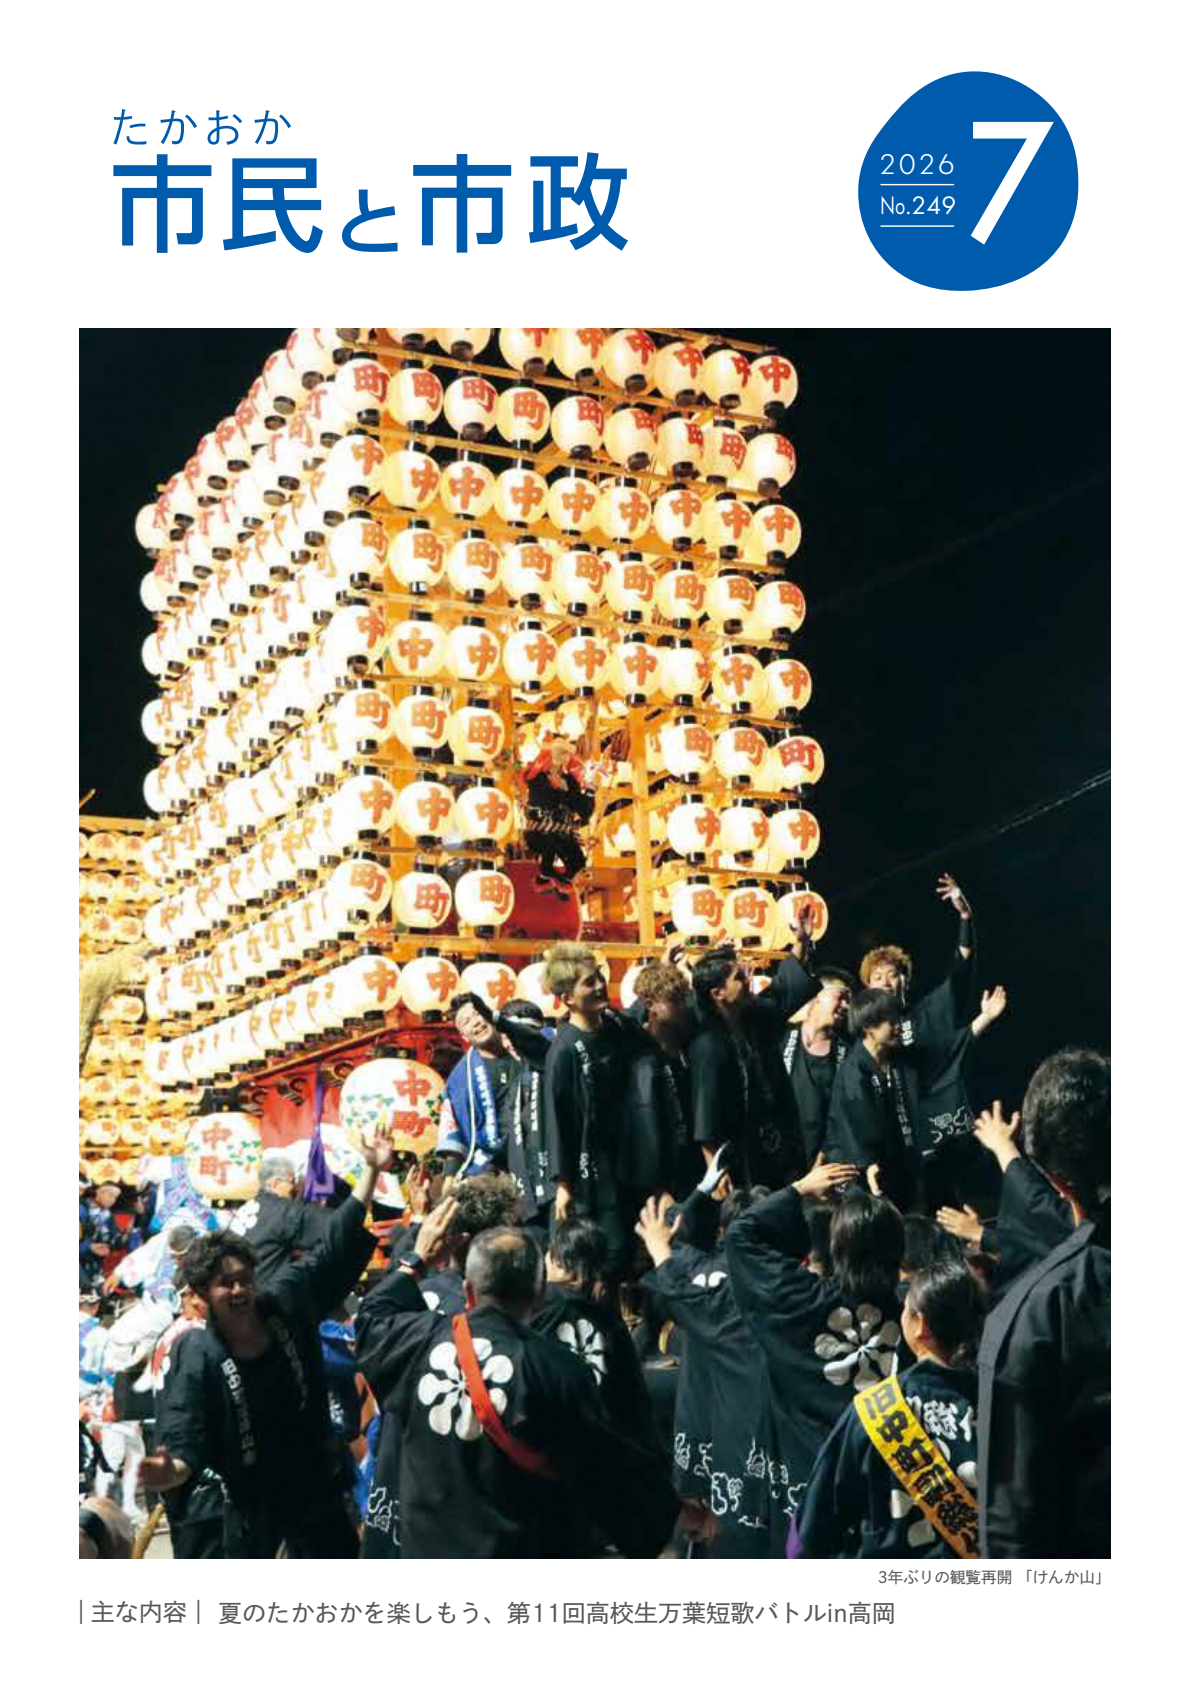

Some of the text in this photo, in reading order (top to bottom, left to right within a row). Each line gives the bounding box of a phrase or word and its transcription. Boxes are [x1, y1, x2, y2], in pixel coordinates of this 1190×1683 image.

[626, 330, 656, 364] 中
[674, 342, 704, 378] 中
[354, 366, 389, 402] 町
[413, 372, 442, 409] 町
[760, 356, 790, 393] 中
[462, 378, 496, 412] 町
[514, 392, 545, 429] 町
[578, 398, 604, 435] 町
[352, 439, 384, 475] 中
[720, 433, 746, 467] 町
[411, 460, 439, 502] 中
[449, 467, 484, 509] 中
[511, 477, 543, 516] 中
[562, 483, 595, 522] 中
[619, 494, 649, 532] 中
[671, 492, 702, 527] 中
[722, 500, 752, 538] 中
[362, 523, 389, 562] 町
[764, 508, 794, 542] 中
[414, 534, 443, 571] 町
[467, 543, 498, 578] 町
[521, 544, 552, 580] 町
[577, 555, 607, 592] 町
[624, 565, 656, 601] 町
[675, 574, 706, 609] 町
[727, 577, 756, 611] 町
[398, 628, 433, 669] 中
[468, 634, 497, 675] 中
[526, 634, 556, 674] 中
[574, 641, 607, 680] 中
[624, 647, 657, 685] 中
[721, 659, 754, 695] 中
[780, 665, 809, 698] 中
[356, 694, 389, 729] 町
[412, 702, 446, 738] 町
[468, 716, 501, 753] 町
[735, 730, 763, 765] 町
[779, 738, 817, 769] 町
[360, 782, 393, 823] 中
[418, 788, 450, 830] 中
[475, 792, 508, 833] 中
[696, 808, 721, 846] 中
[788, 813, 817, 848] 中
[350, 864, 386, 902] 町
[480, 875, 511, 914] 町
[413, 883, 448, 921] 町
[693, 890, 724, 928] 町
[734, 895, 768, 928] 町
[363, 962, 399, 1002] 中
[427, 962, 458, 1002] 中
[487, 968, 517, 1008] 中
[392, 1069, 431, 1138] 中町
[200, 1121, 232, 1184] 中町
